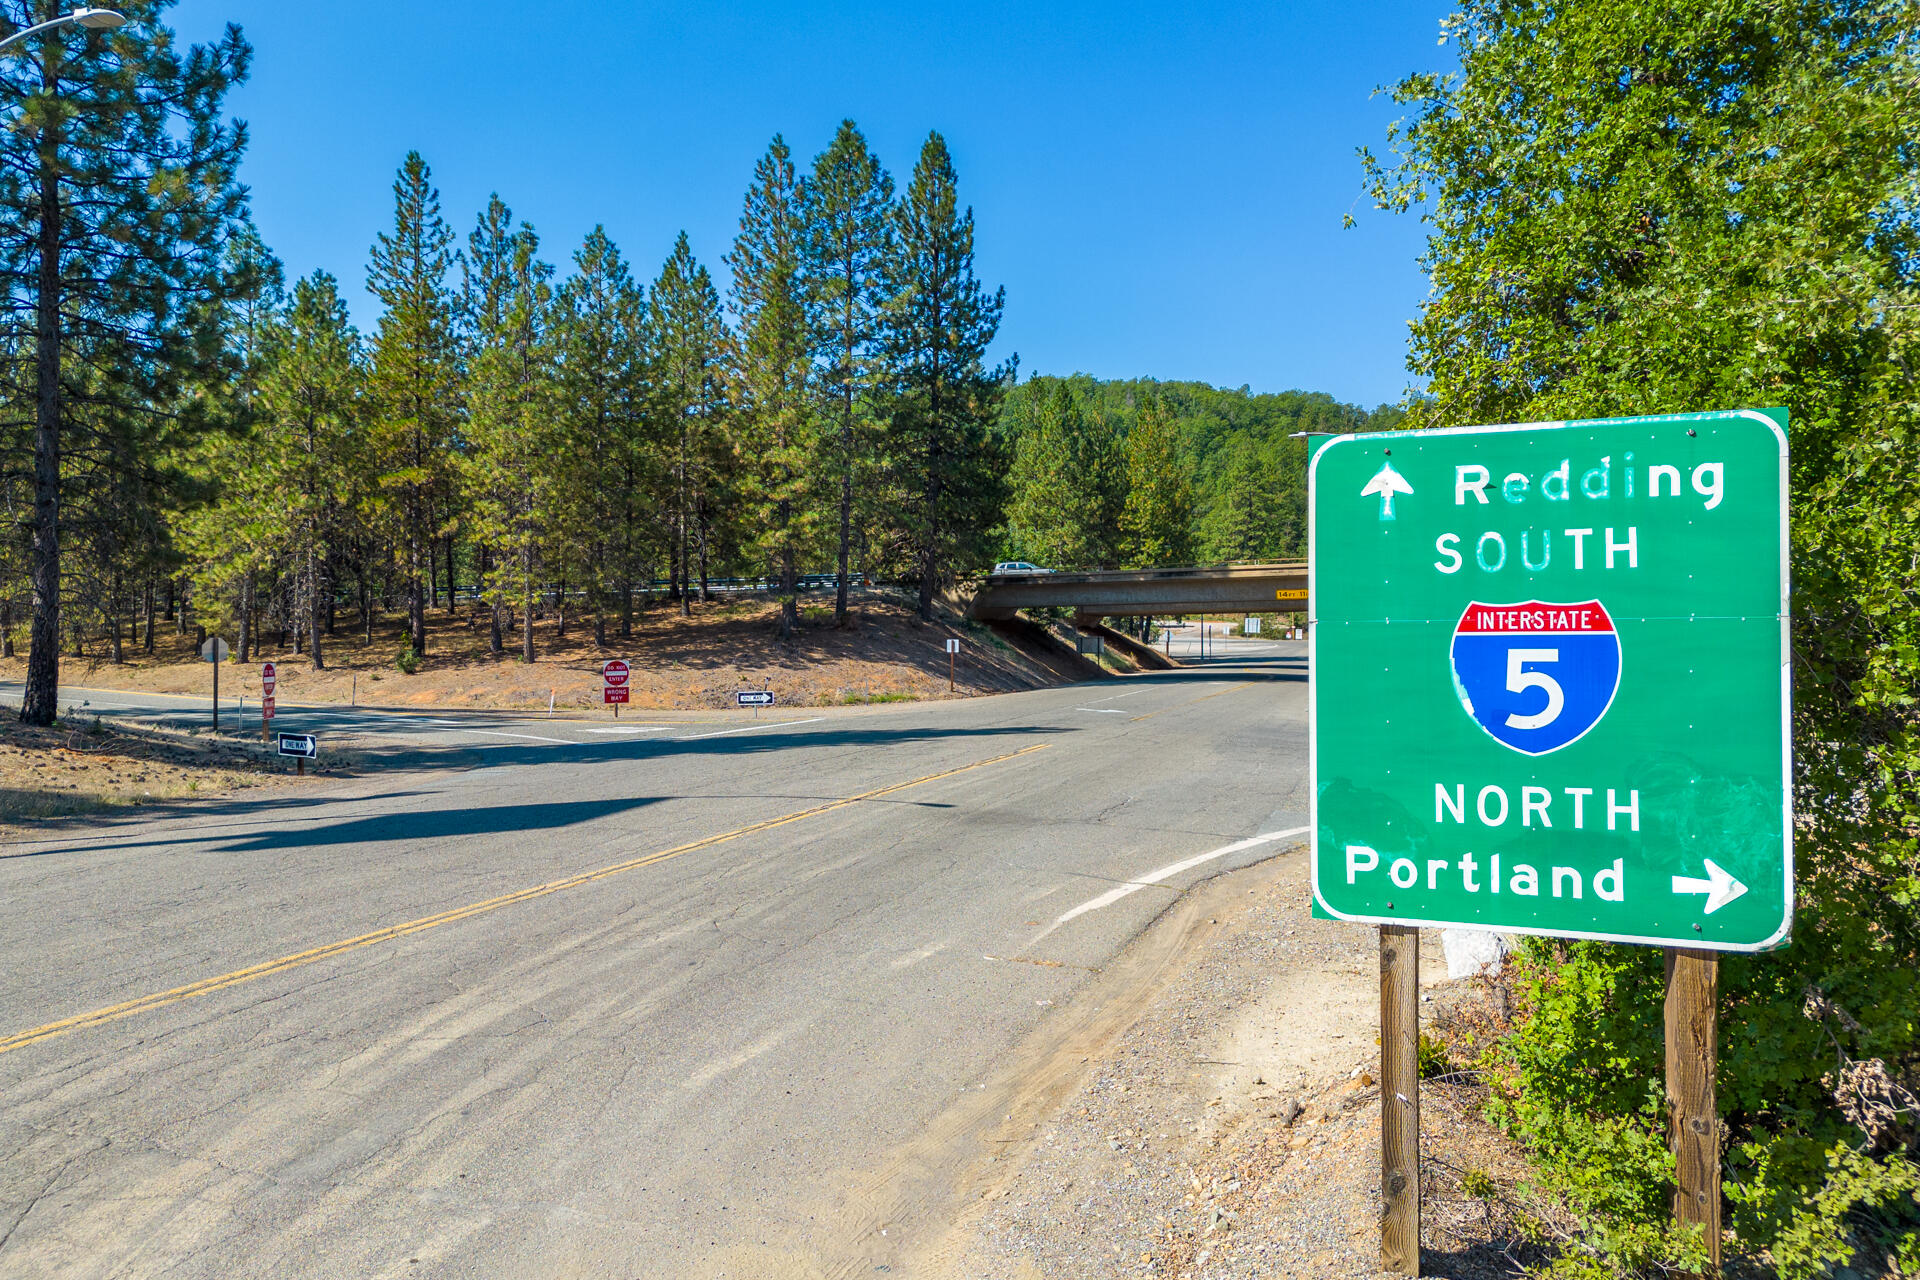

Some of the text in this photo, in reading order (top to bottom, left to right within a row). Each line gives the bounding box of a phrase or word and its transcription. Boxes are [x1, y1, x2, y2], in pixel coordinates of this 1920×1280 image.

[1455, 452, 1724, 509] Redding
[1434, 527, 1638, 574] SOUTH
[1476, 610, 1593, 631] INTERSTATE
[1504, 648, 1564, 730] 5
[295, 741, 308, 749] WAY
[1435, 783, 1639, 831] NORTH
[1346, 846, 1624, 901] Portland
